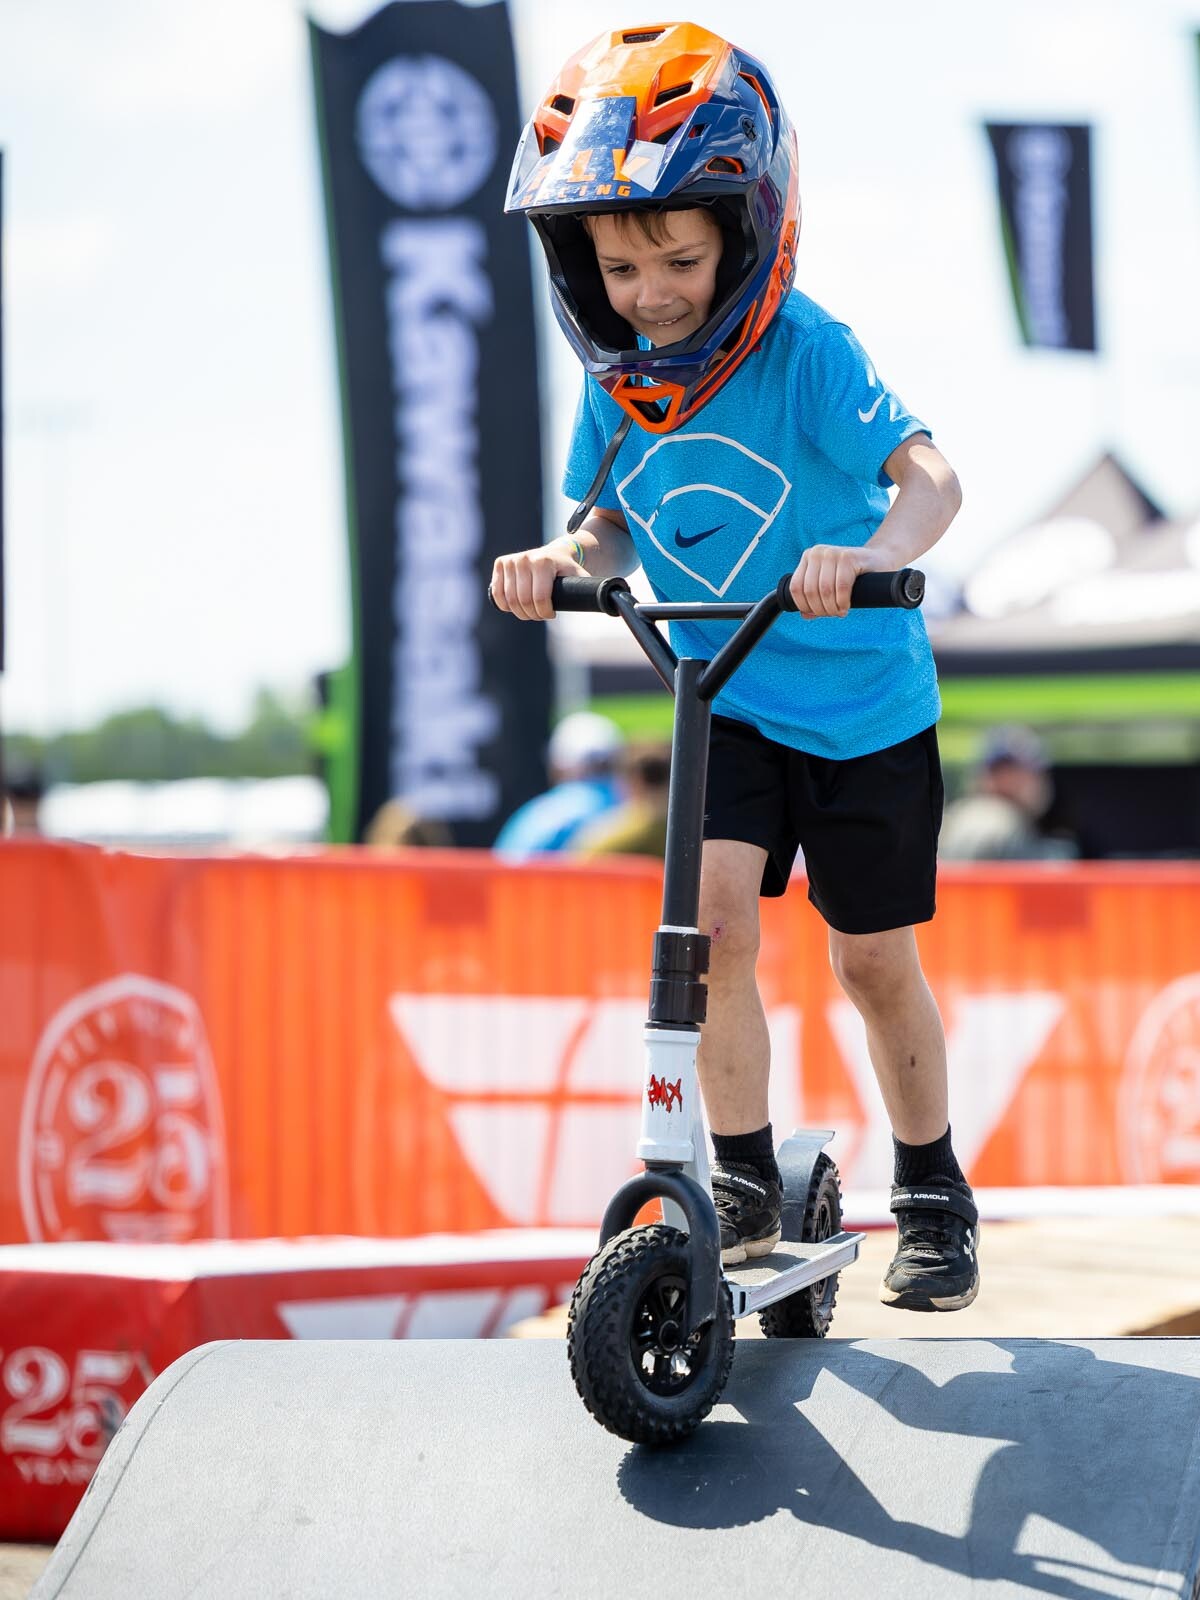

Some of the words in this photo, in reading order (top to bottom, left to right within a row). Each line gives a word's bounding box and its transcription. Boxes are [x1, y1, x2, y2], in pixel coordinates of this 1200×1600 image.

[66, 1060, 208, 1209] 25
[732, 1176, 767, 1196] ARMOUR
[913, 1193, 949, 1201] ARMOUR
